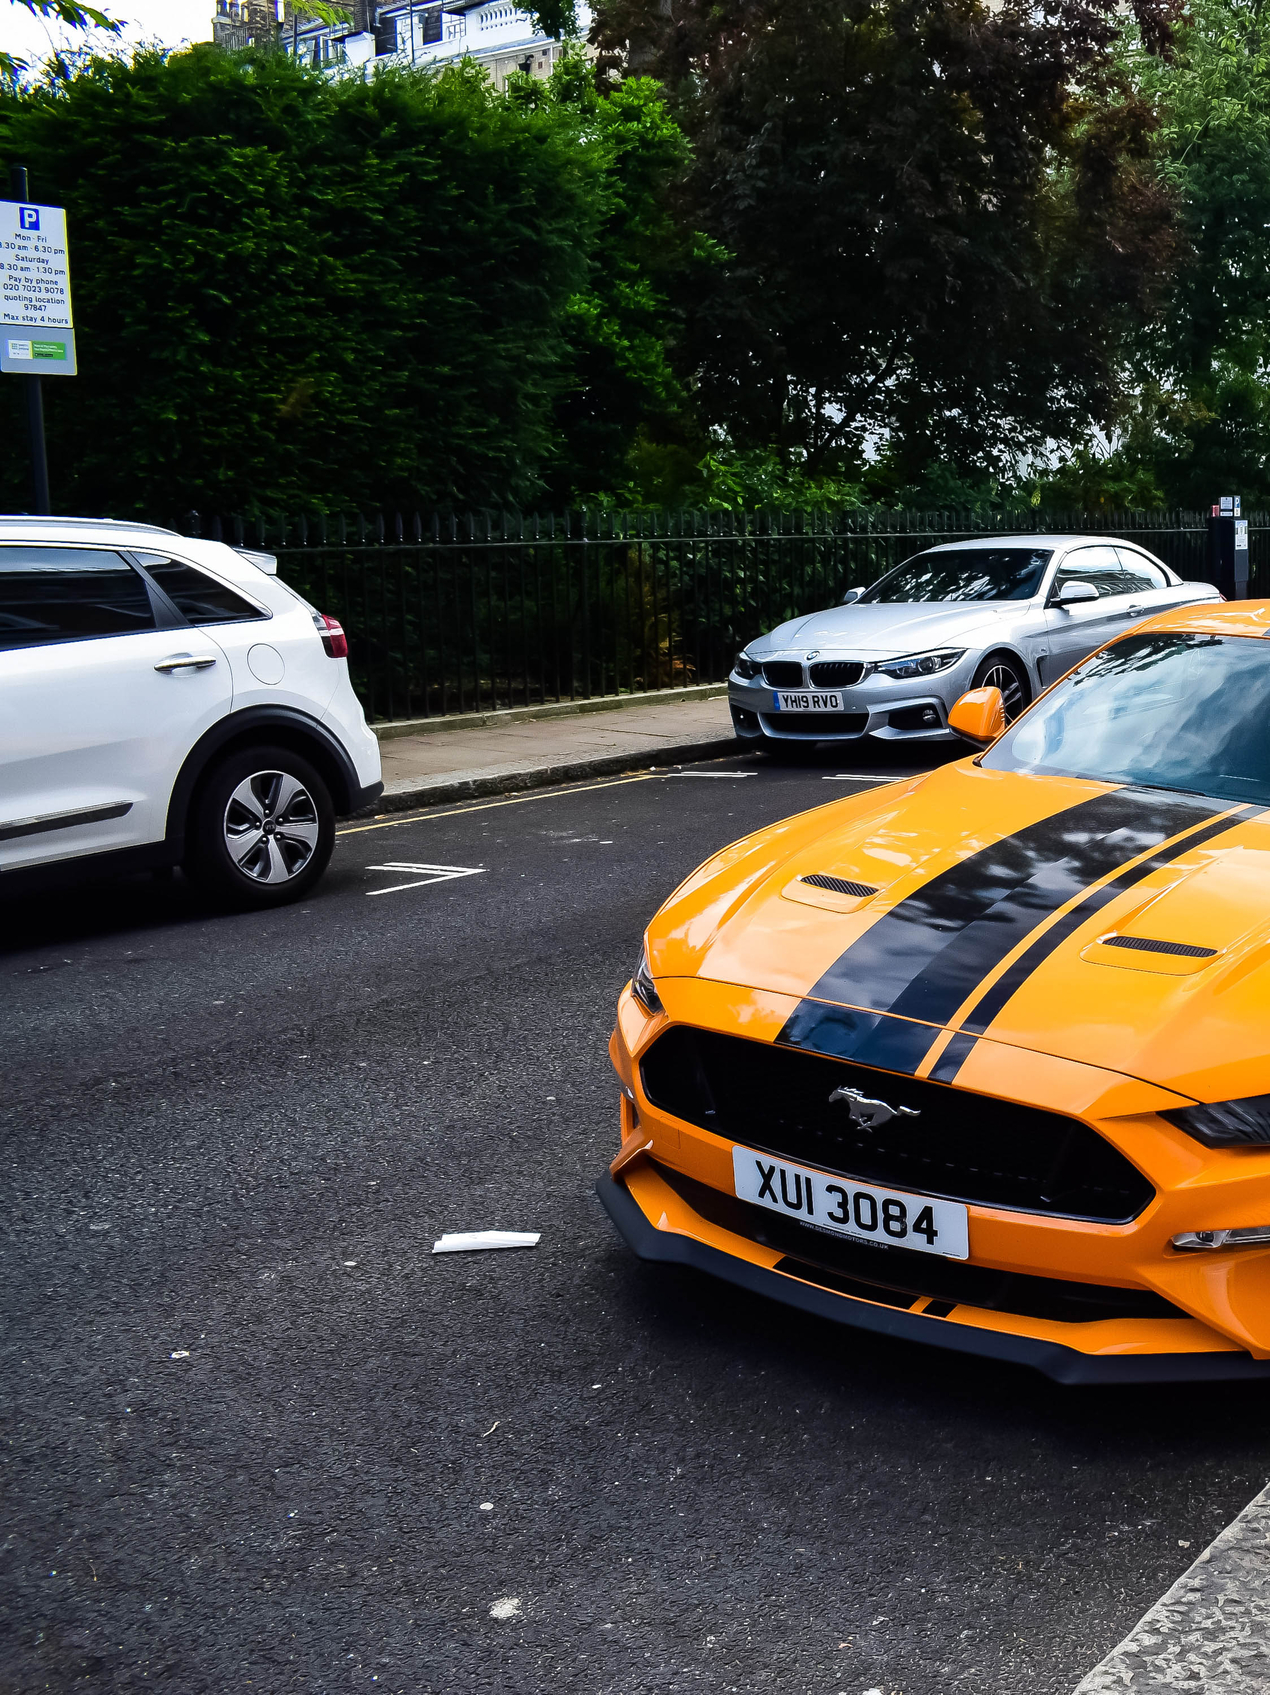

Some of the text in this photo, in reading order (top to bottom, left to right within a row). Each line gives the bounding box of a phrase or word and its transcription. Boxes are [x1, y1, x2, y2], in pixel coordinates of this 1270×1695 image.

[14, 233, 31, 241] Mon
[37, 235, 47, 243] Fri
[34, 245, 52, 253] 6.30
[14, 254, 50, 265] Saturday
[19, 265, 31, 273] am
[36, 267, 53, 275] 1.30
[8, 274, 59, 286] Pay by phone
[3, 283, 64, 295] 020 7023 9078
[4, 294, 65, 305] quoting location
[21, 315, 38, 323] stay
[47, 316, 69, 324] hours
[782, 694, 839, 709] YH19 RVO
[755, 1159, 938, 1246] XUI 3084
